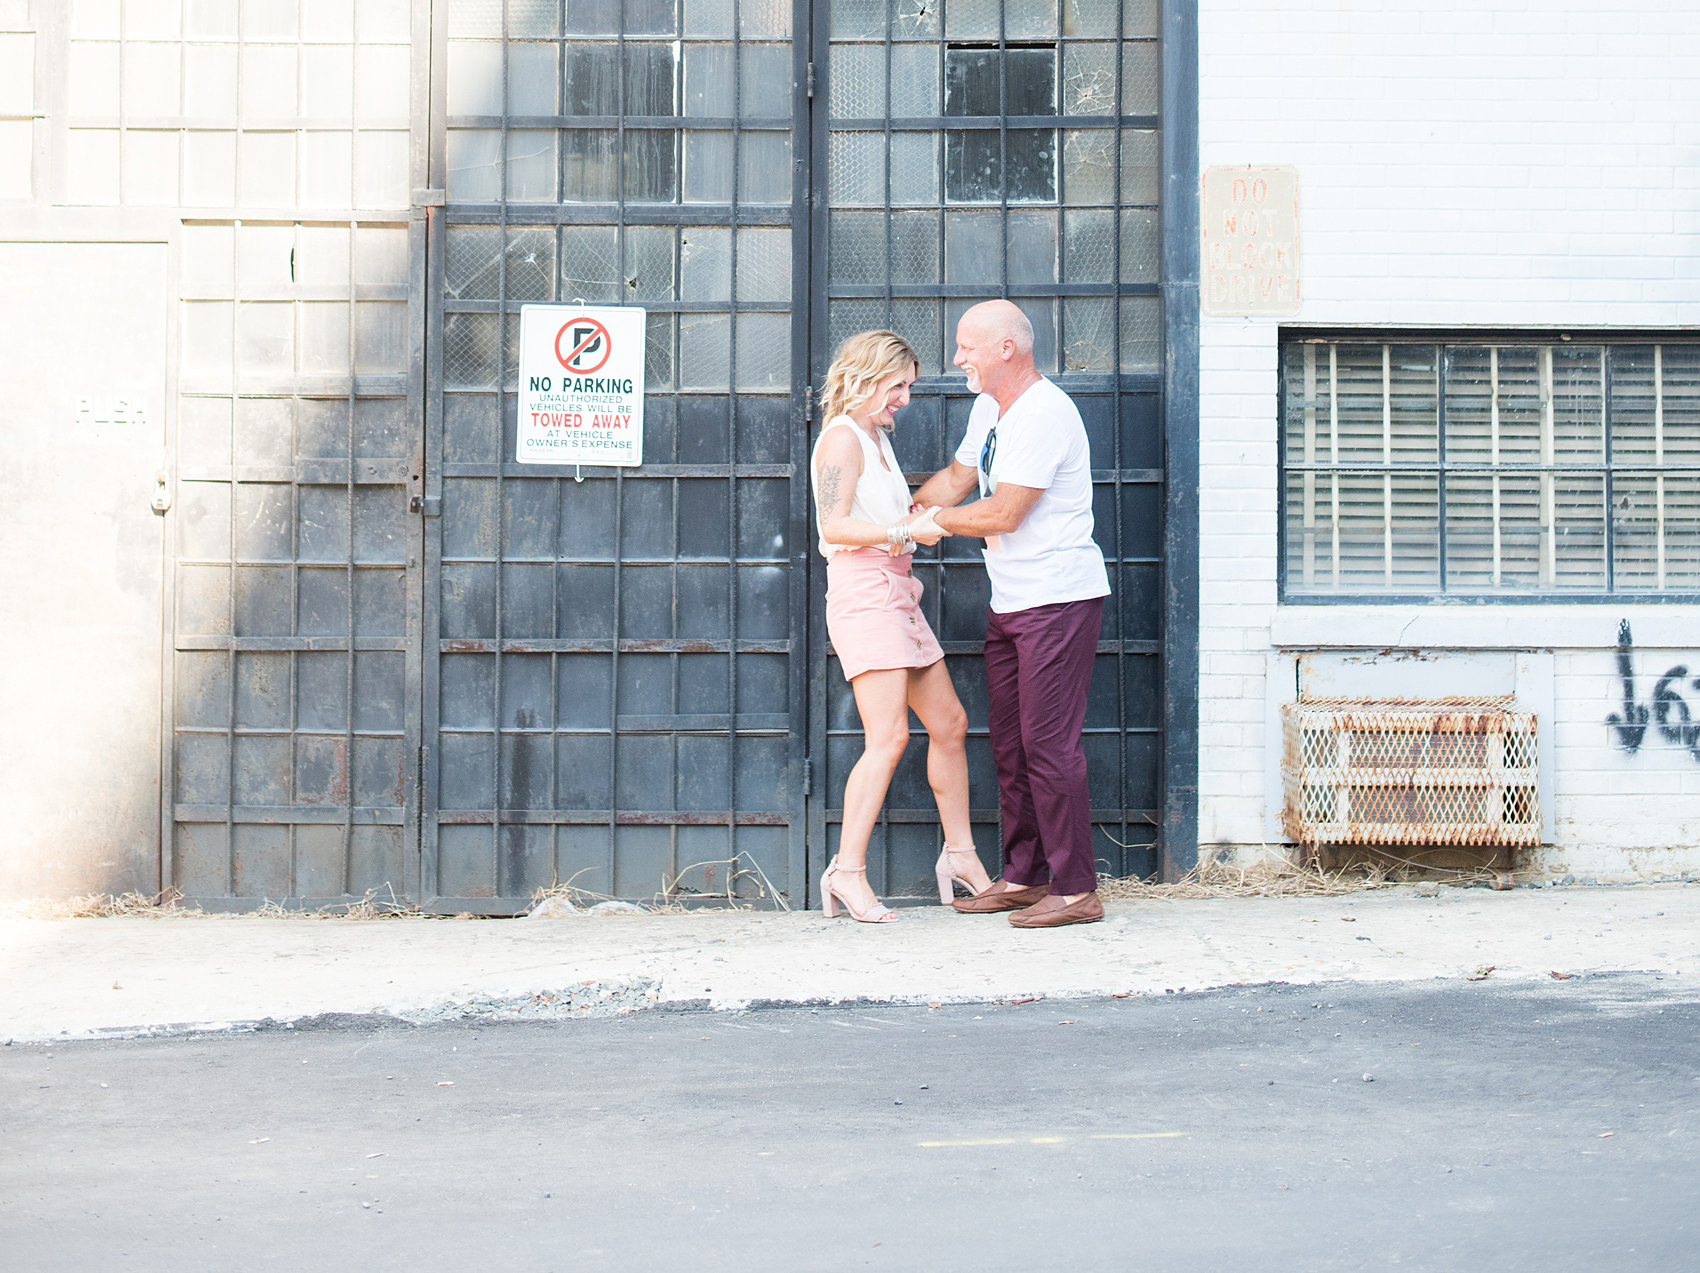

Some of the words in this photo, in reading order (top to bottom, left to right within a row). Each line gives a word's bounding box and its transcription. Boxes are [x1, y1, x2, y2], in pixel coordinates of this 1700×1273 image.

[1233, 178, 1267, 204] DO
[1223, 209, 1278, 237] NOT
[1210, 242, 1293, 271] BLOCK
[1210, 275, 1293, 303] DRIVE
[530, 377, 552, 392] NO
[563, 377, 633, 394] PARKING
[539, 394, 623, 404] UNAUTHORIZED
[530, 403, 583, 412] VEHICLES
[587, 404, 613, 413] WILL
[618, 405, 633, 414] BE
[531, 413, 583, 428] TOWED
[592, 414, 631, 429] AWAY
[547, 430, 560, 438] AT
[565, 430, 613, 439] VEHICLE
[526, 438, 579, 448] OWNER'S
[581, 439, 633, 449] EXPENSE
